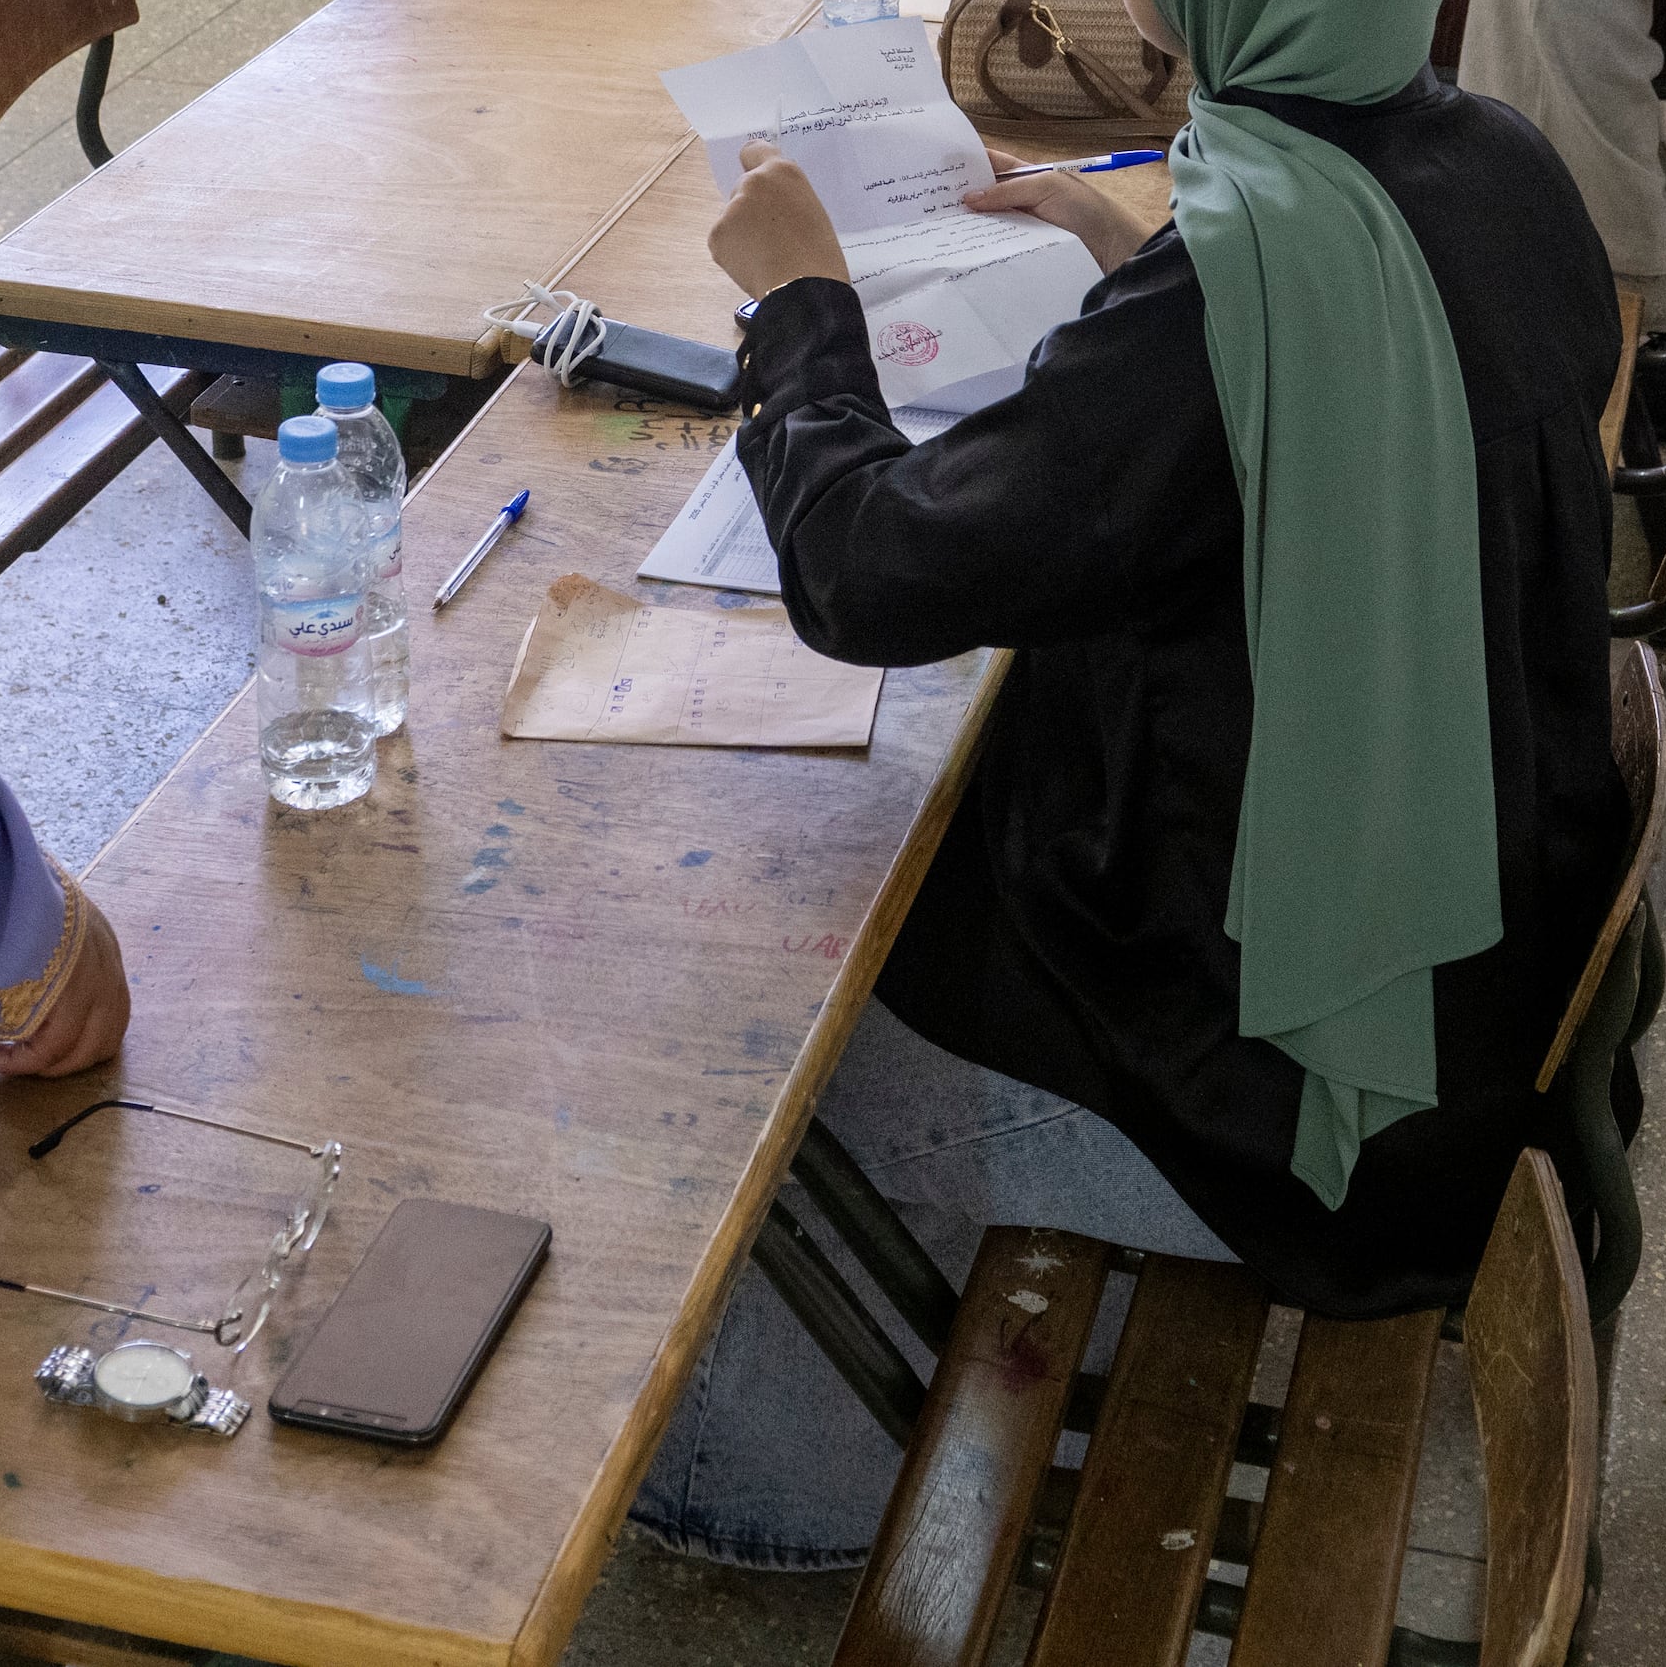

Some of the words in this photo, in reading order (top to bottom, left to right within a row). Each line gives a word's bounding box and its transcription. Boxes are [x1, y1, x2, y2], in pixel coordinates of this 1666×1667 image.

[747, 130, 768, 141] 2026
[289, 620, 317, 639] علي
[319, 616, 354, 639] سيدي
